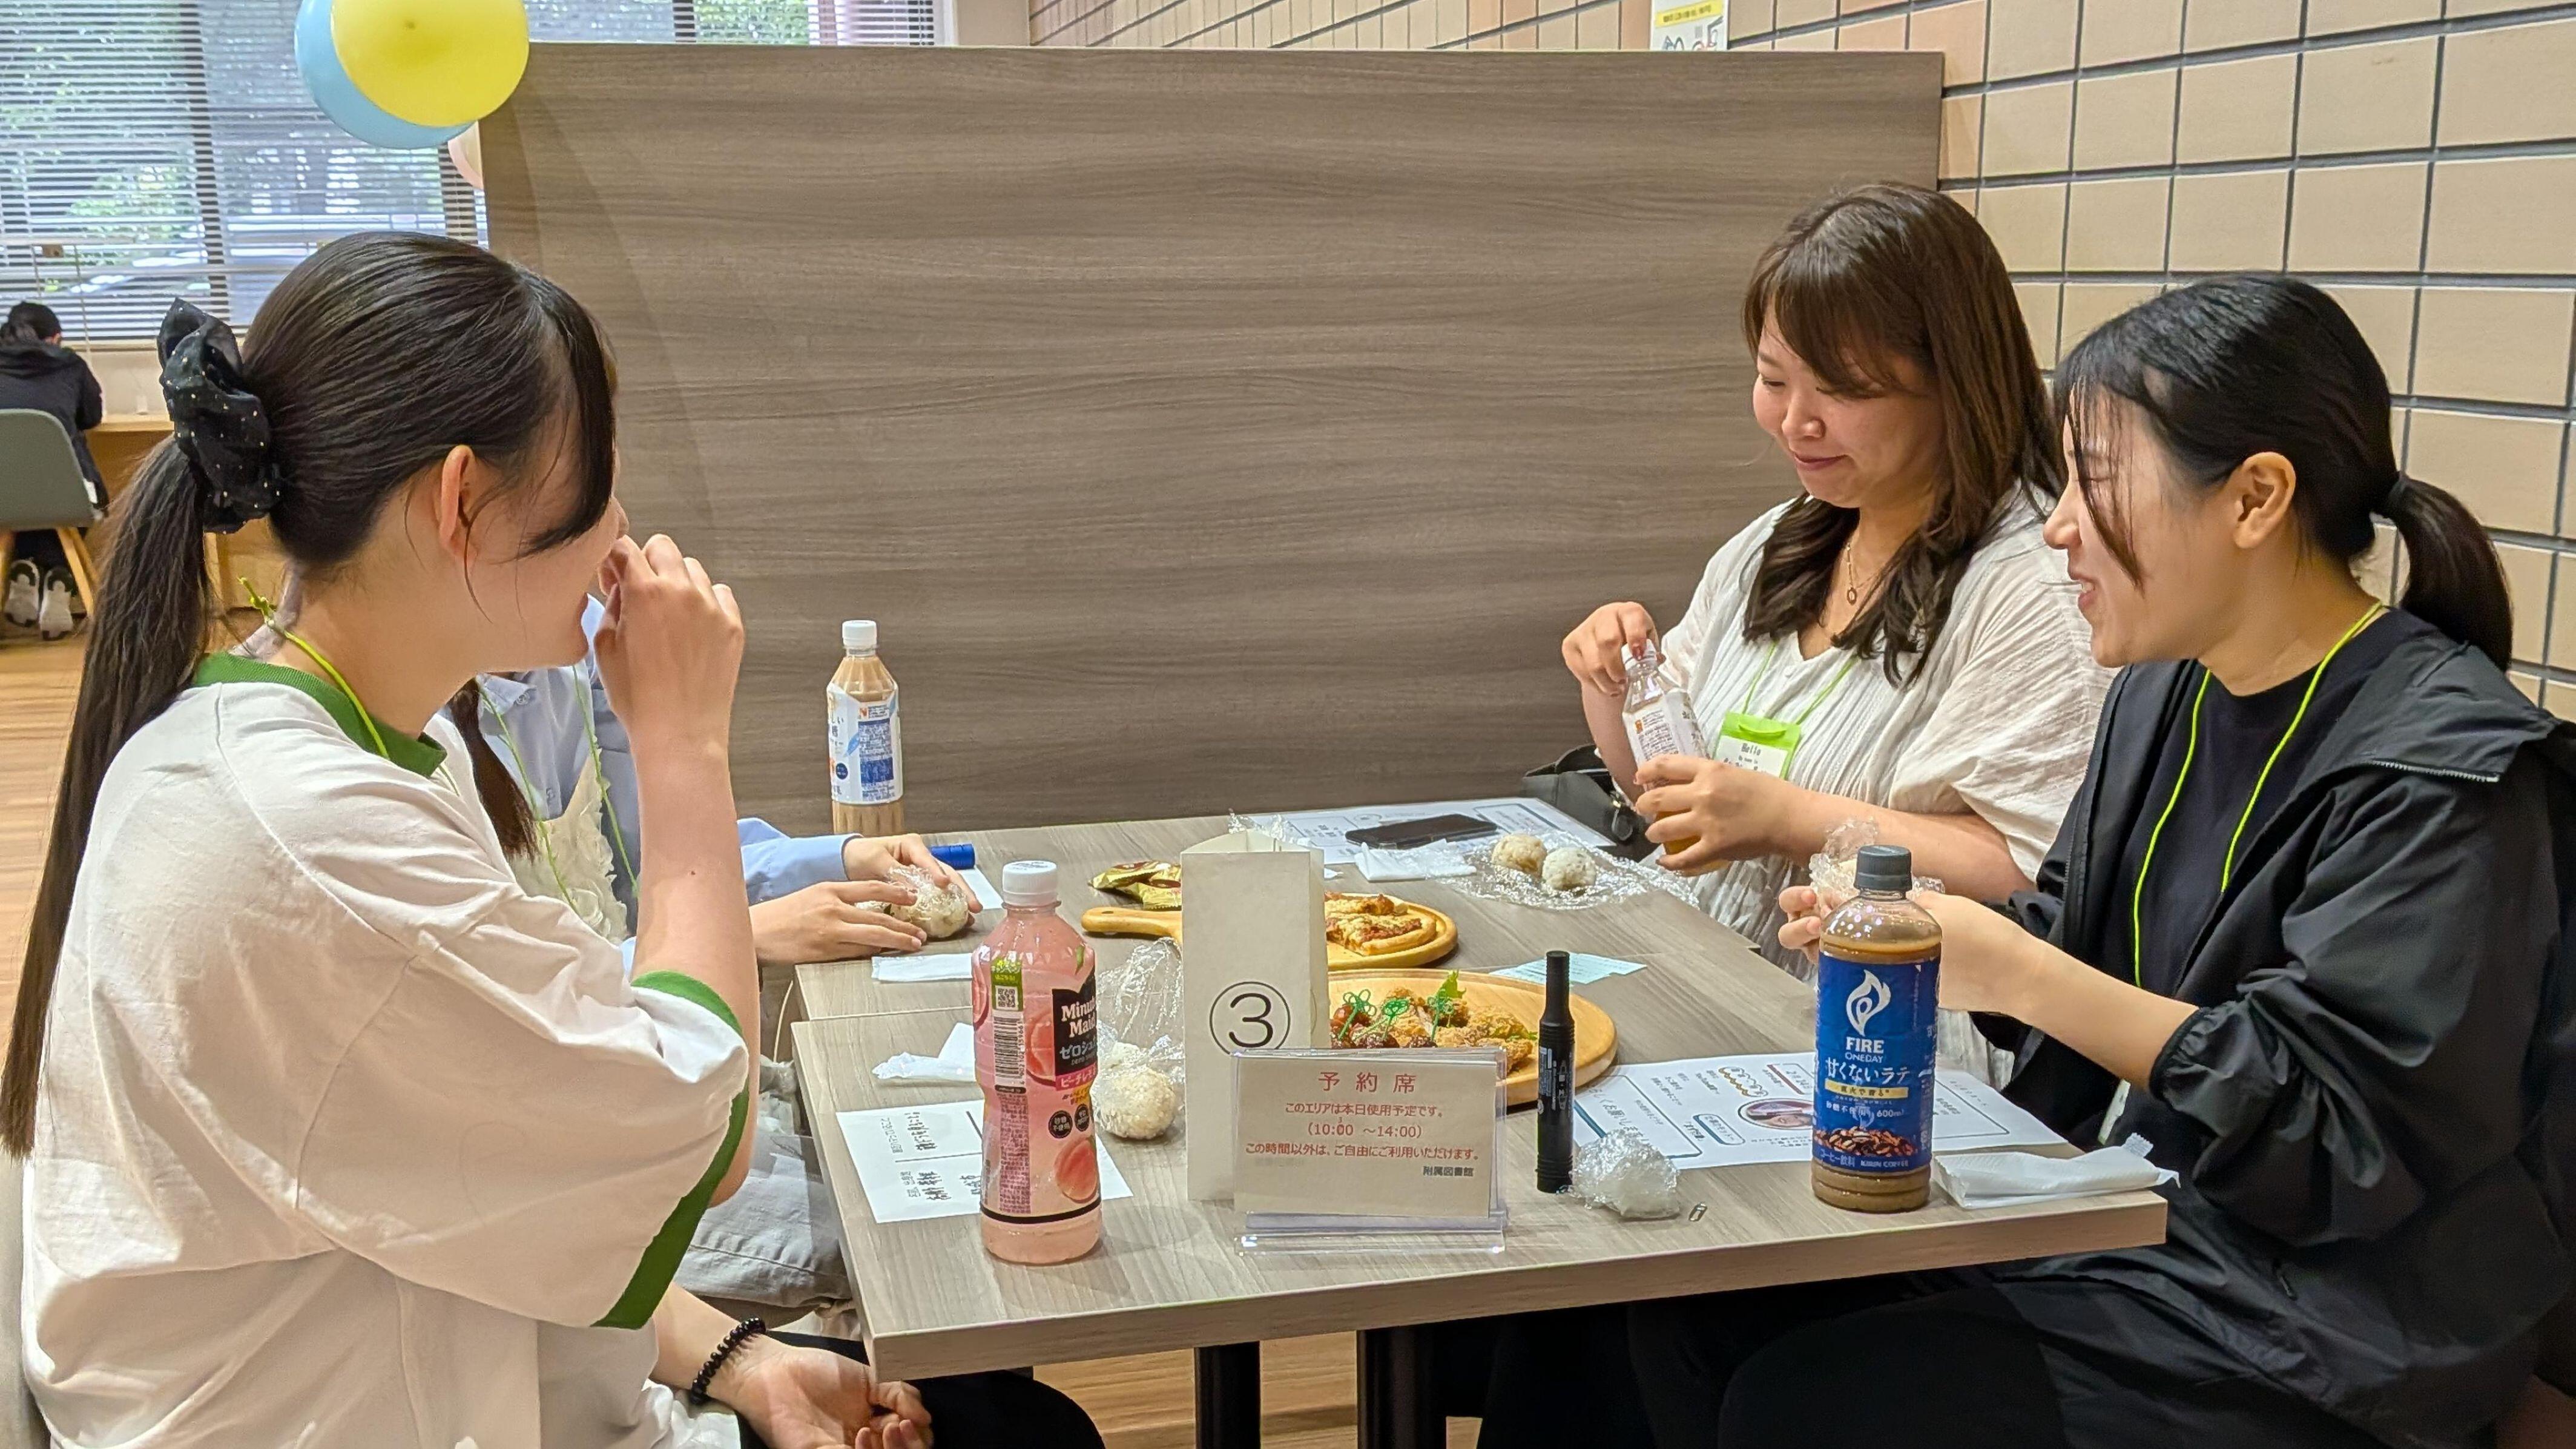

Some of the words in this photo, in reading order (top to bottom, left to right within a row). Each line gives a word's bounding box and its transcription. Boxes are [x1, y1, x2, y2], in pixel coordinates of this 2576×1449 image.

[1069, 1011, 1096, 1038] Maid
[1845, 1036, 1885, 1054] FIRE
[1845, 1052, 1884, 1063] ONEDAY
[1825, 1057, 1911, 1085] 甘くないラテ
[1318, 1071, 1417, 1094] 予約席
[1285, 1102, 1443, 1118] このエリアは本日使用予定です。
[1245, 1143, 1479, 1160] この時間以外は、ご自由にご利用いただけます。
[1422, 1166, 1474, 1177] 附属図書館
